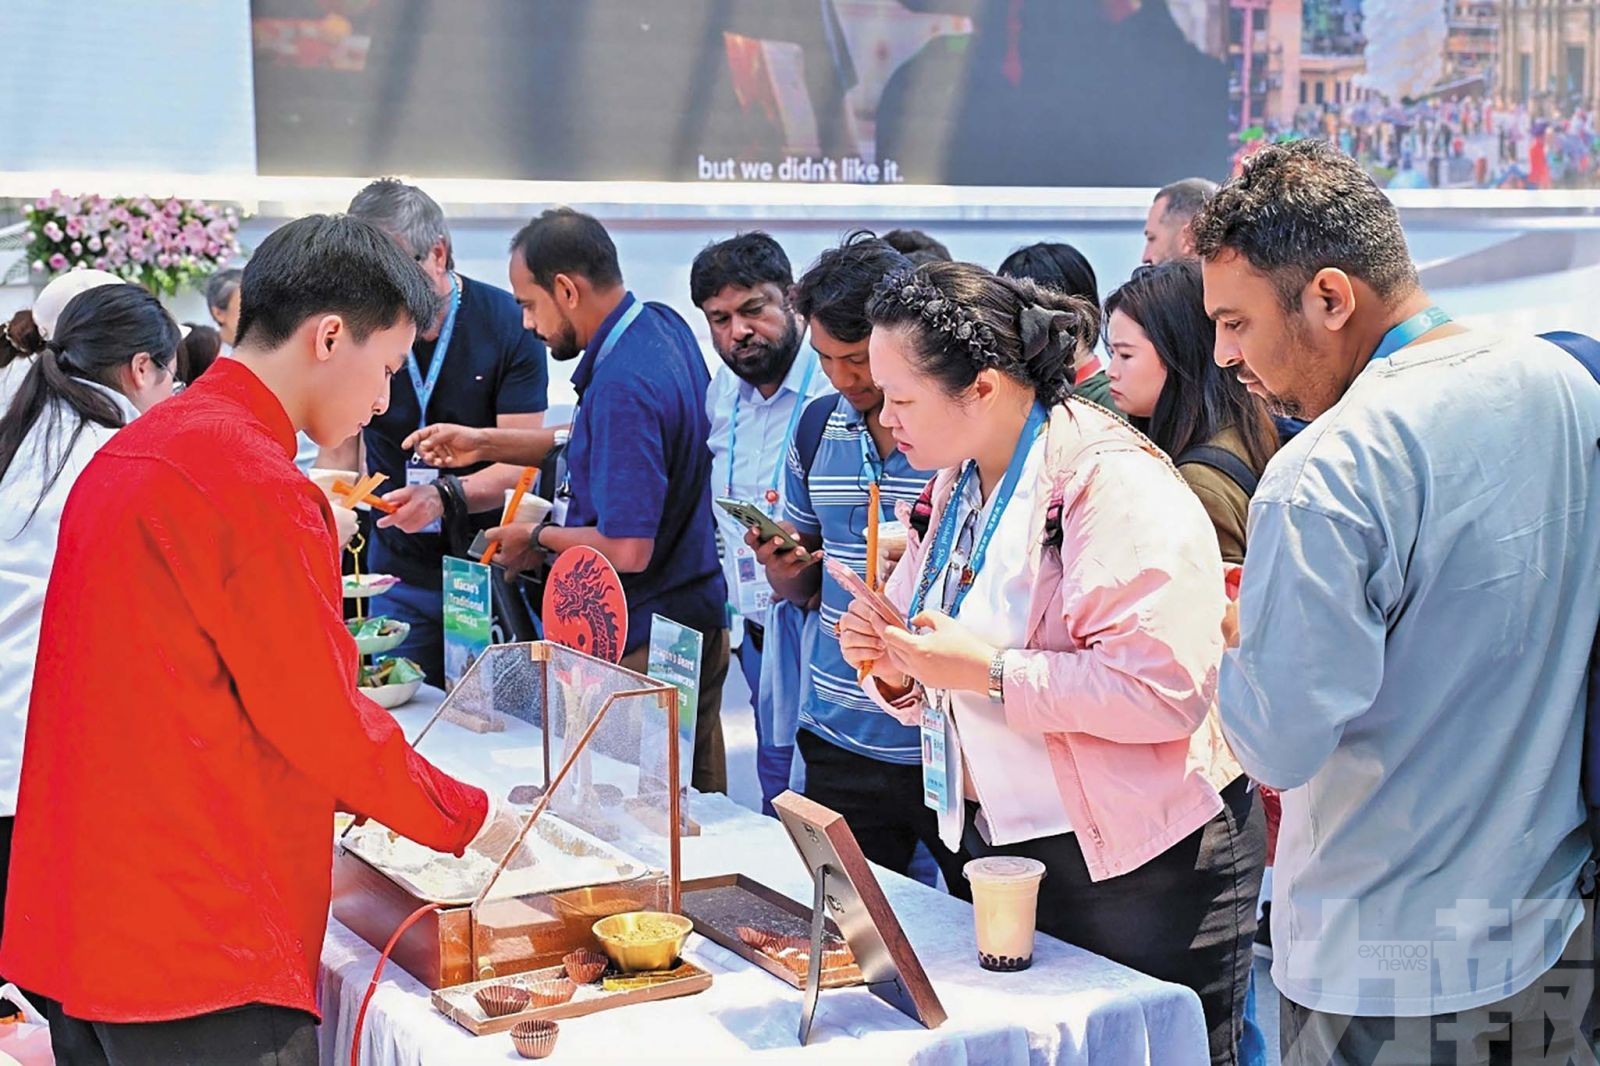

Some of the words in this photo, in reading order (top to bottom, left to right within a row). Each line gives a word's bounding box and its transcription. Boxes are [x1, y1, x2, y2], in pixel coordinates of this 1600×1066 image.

[698, 154, 735, 180] but
[740, 161, 773, 180] we
[778, 156, 837, 182] didn't
[842, 157, 880, 182] like
[884, 158, 904, 182] it.
